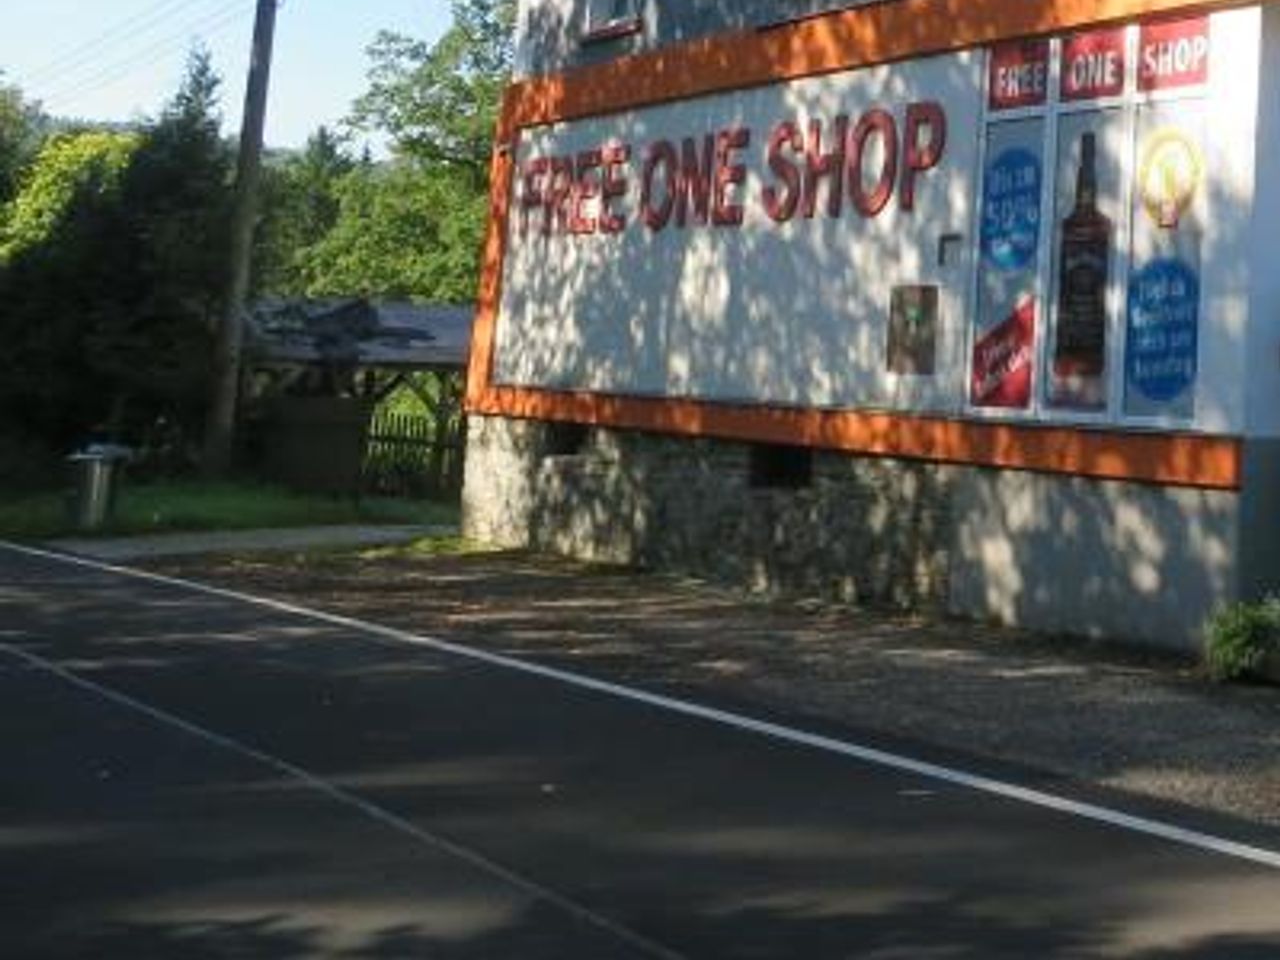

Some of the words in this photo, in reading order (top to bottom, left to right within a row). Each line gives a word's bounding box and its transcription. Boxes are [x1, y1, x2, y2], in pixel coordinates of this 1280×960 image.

[998, 62, 1047, 97] FREE
[1071, 50, 1120, 90] ONE
[1142, 36, 1207, 77] SHOP
[522, 141, 632, 235] FREE
[641, 126, 751, 232] ONE
[762, 100, 946, 223] SHOP
